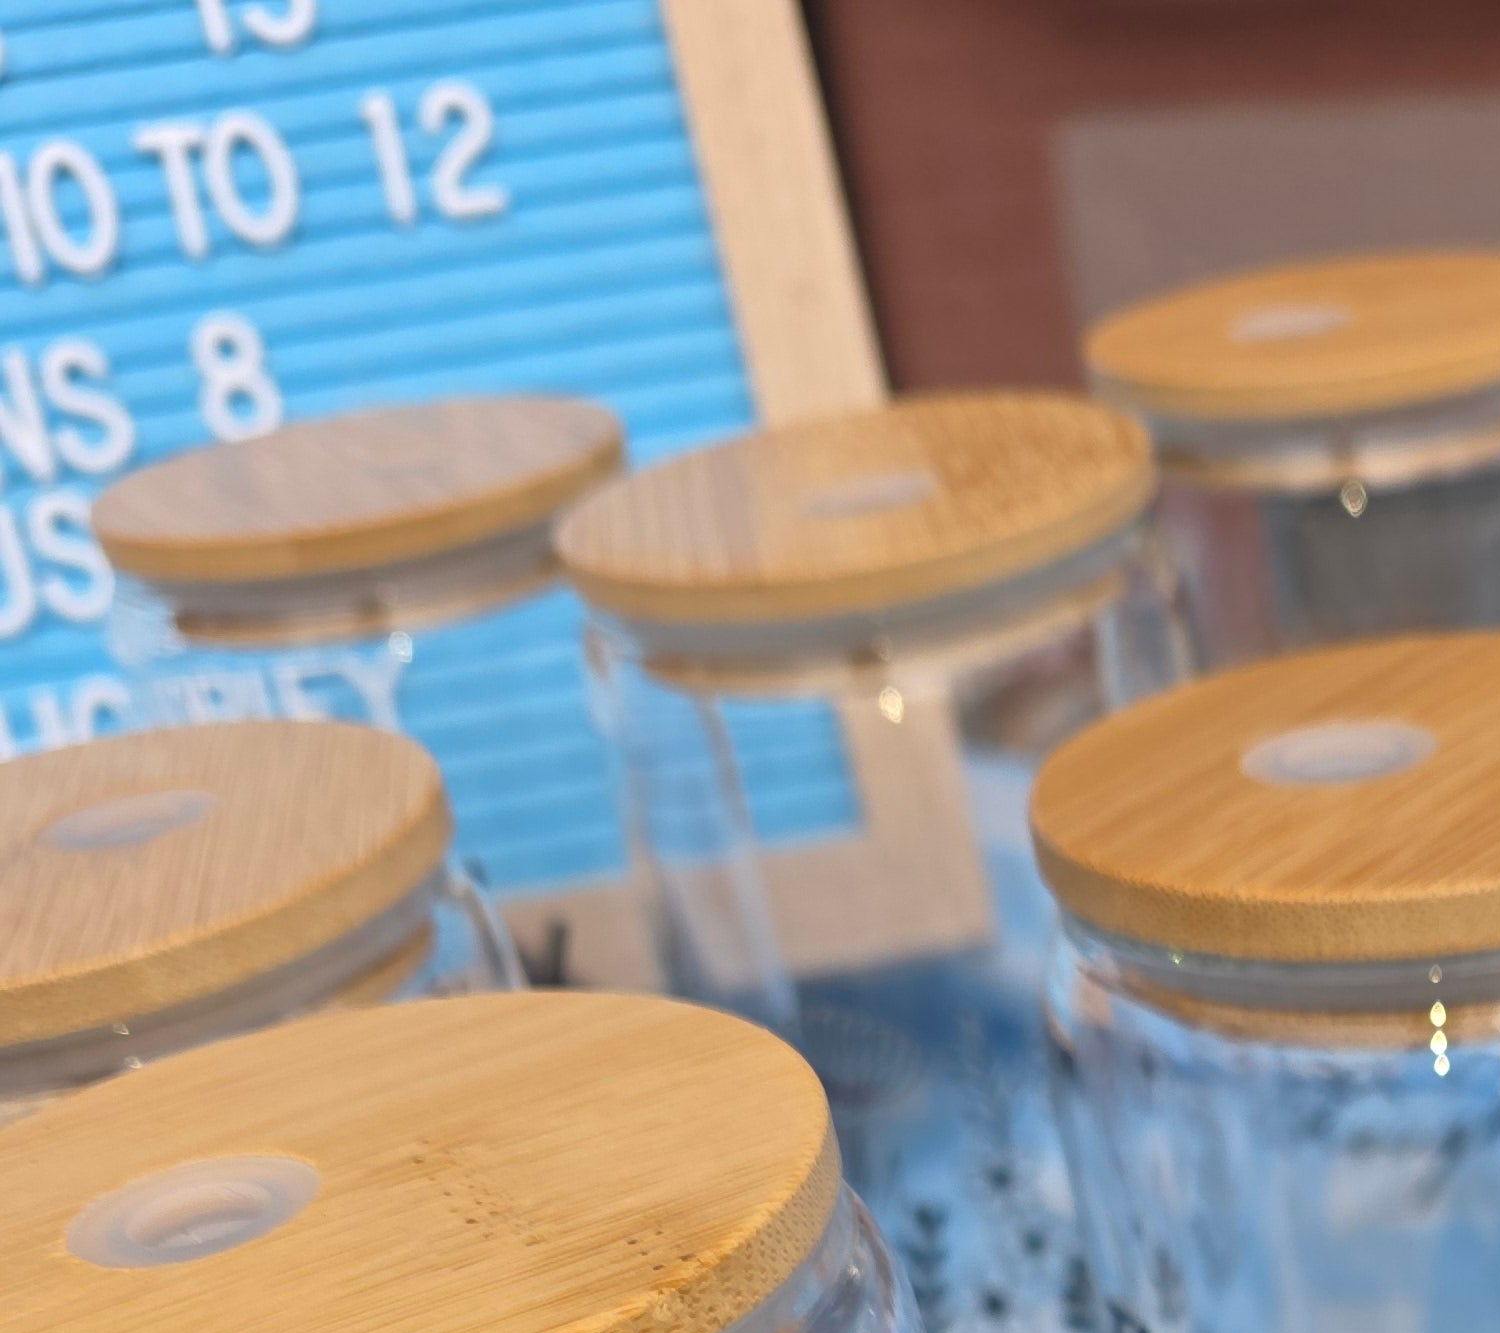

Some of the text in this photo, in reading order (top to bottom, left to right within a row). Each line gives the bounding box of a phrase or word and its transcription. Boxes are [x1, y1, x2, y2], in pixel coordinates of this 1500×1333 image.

[130, 110, 298, 260] TO
[359, 80, 510, 227] 12
[190, 310, 283, 443] 8
